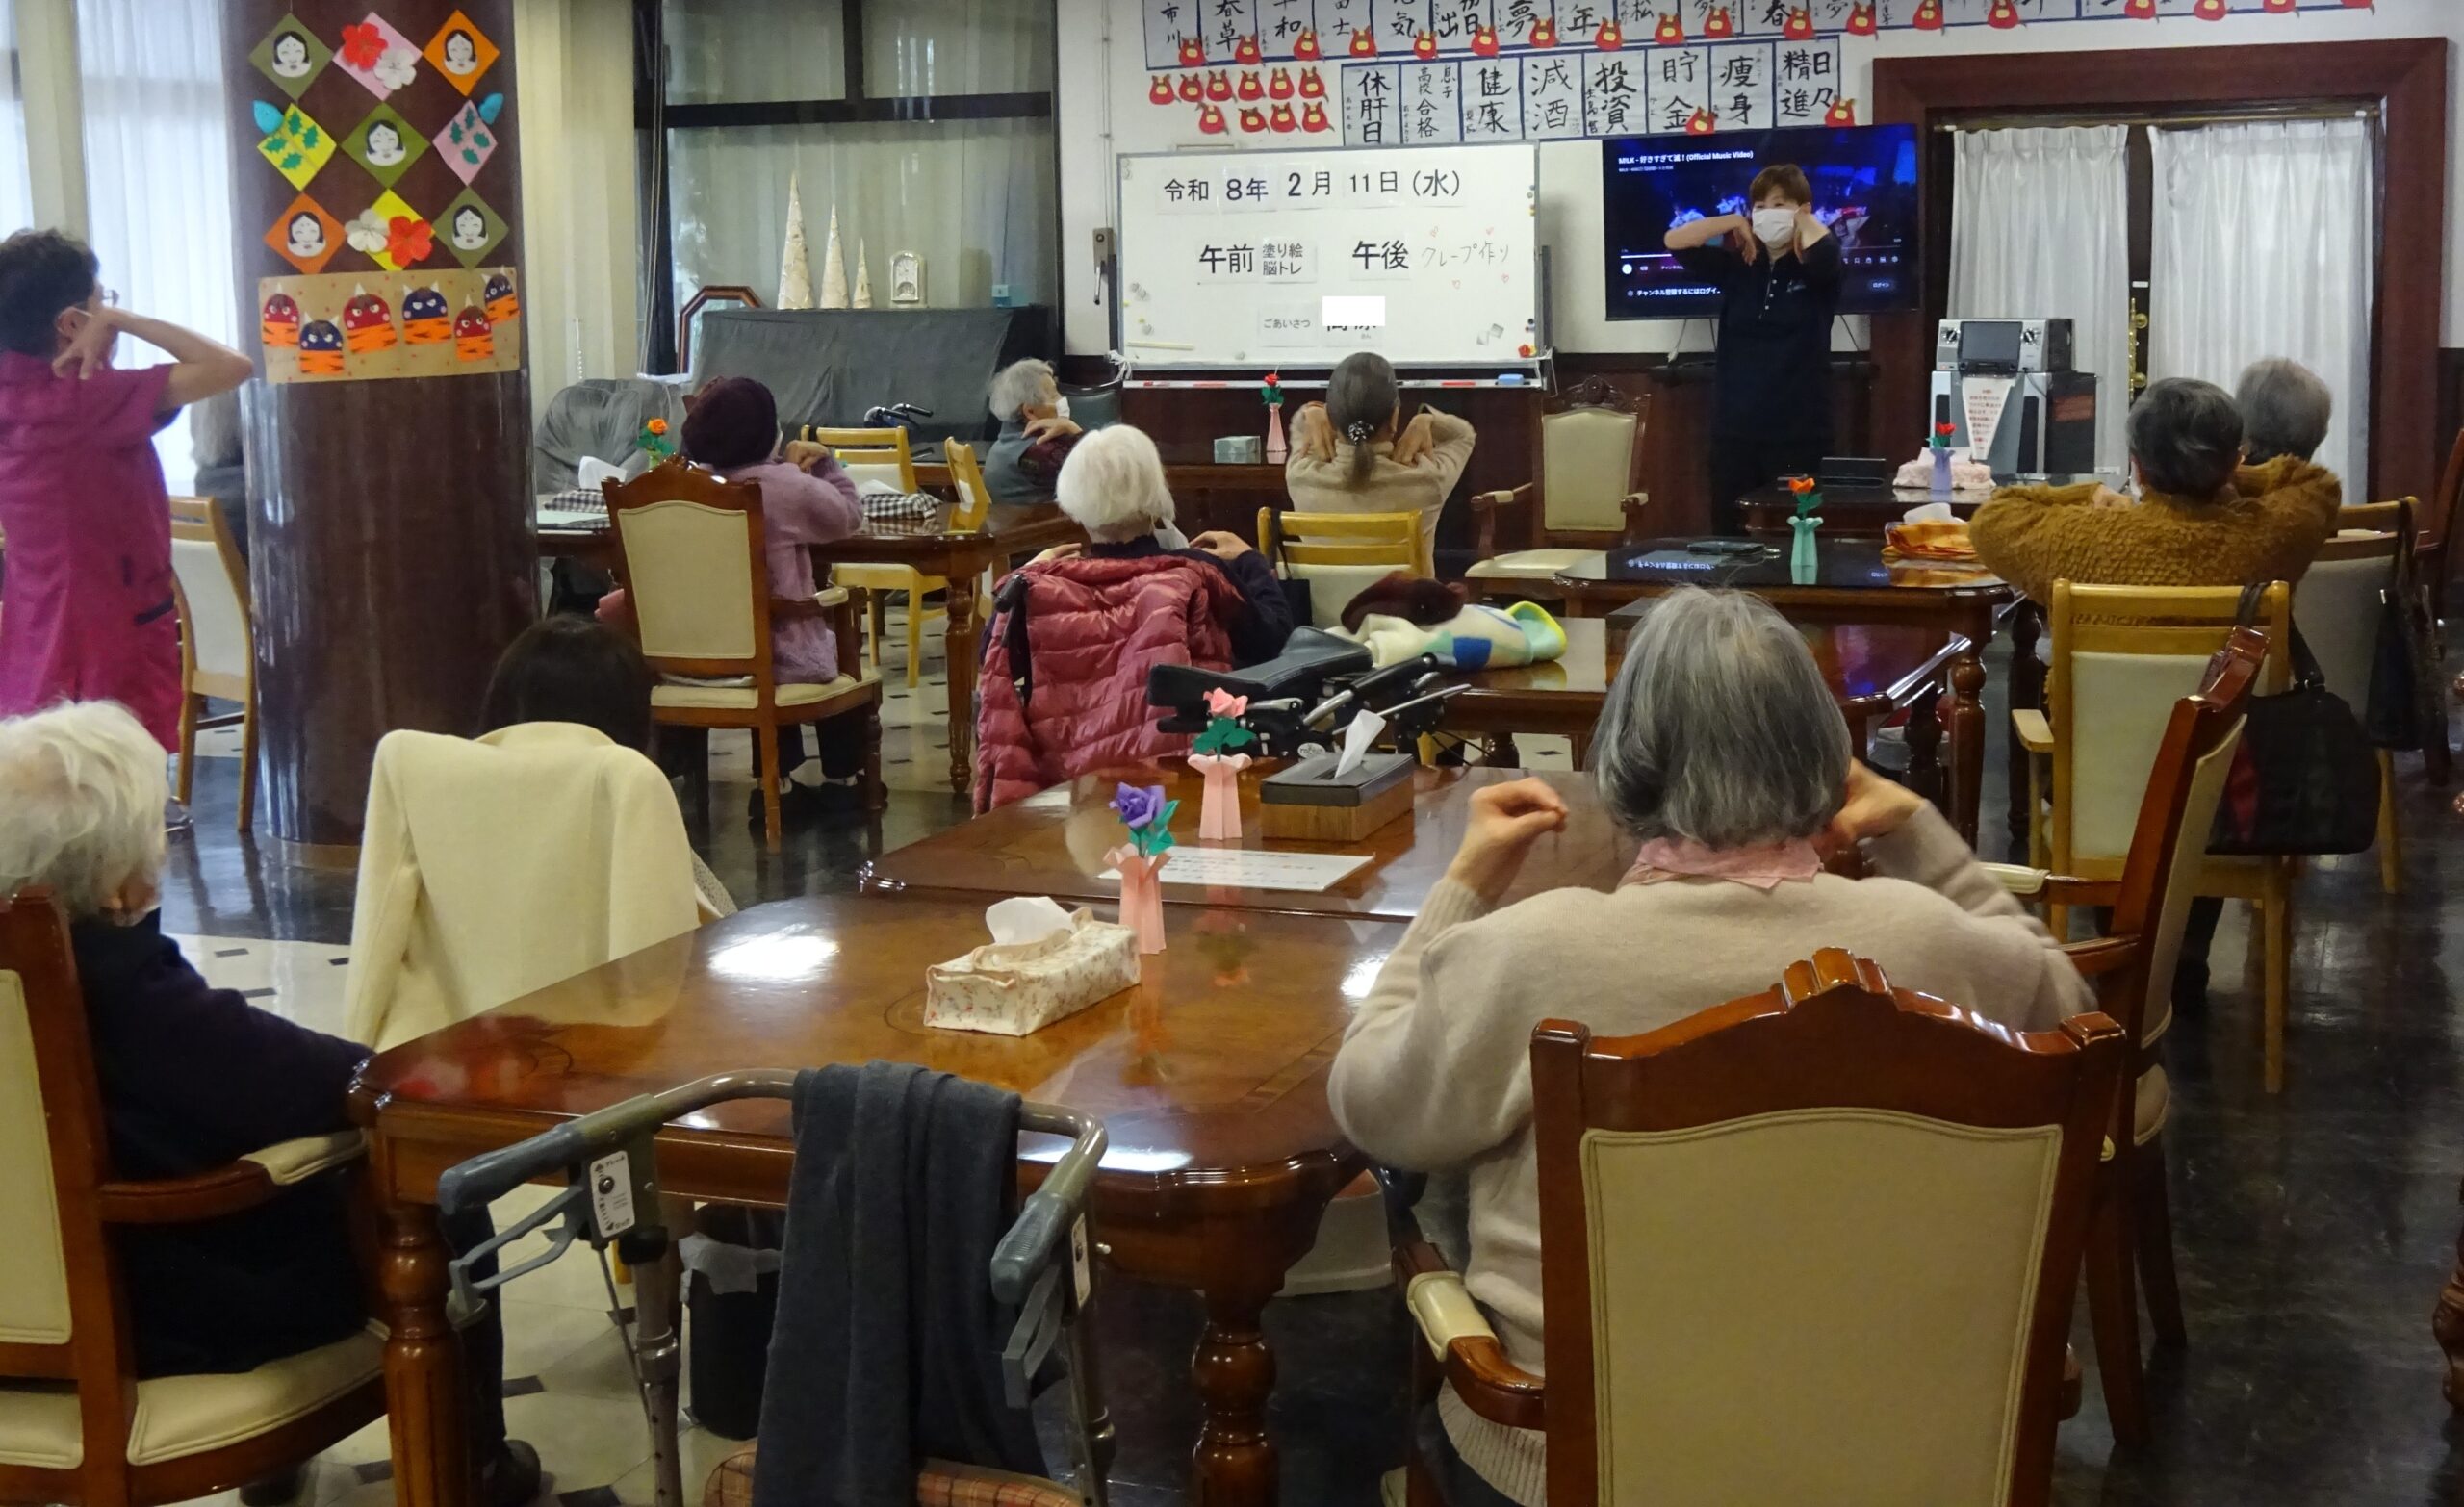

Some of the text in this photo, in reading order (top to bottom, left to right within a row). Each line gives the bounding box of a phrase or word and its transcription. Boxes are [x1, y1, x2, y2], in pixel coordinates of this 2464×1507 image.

[1416, 65, 1440, 139] 高校合格
[1441, 64, 1456, 99] 息子
[1476, 65, 1512, 134] 健康
[1531, 59, 1573, 132] 減酒
[1594, 60, 1638, 134] 投資
[1663, 50, 1699, 129] 貯金
[1719, 56, 1758, 125] 痩身
[1781, 48, 1812, 117] 精進
[1810, 50, 1834, 108] 日々
[1358, 70, 1392, 144] 休肝日
[1712, 152, 1732, 161] Music
[1732, 150, 1754, 159] Video)
[1164, 177, 1209, 202] 令和
[1199, 243, 1255, 274] 午前
[1262, 243, 1304, 259] 塗り絵
[1262, 261, 1303, 276] 脳トレ
[1351, 240, 1410, 270] 午後
[1421, 241, 1509, 268] クレープ作り
[1263, 318, 1311, 329] ごあいさつ
